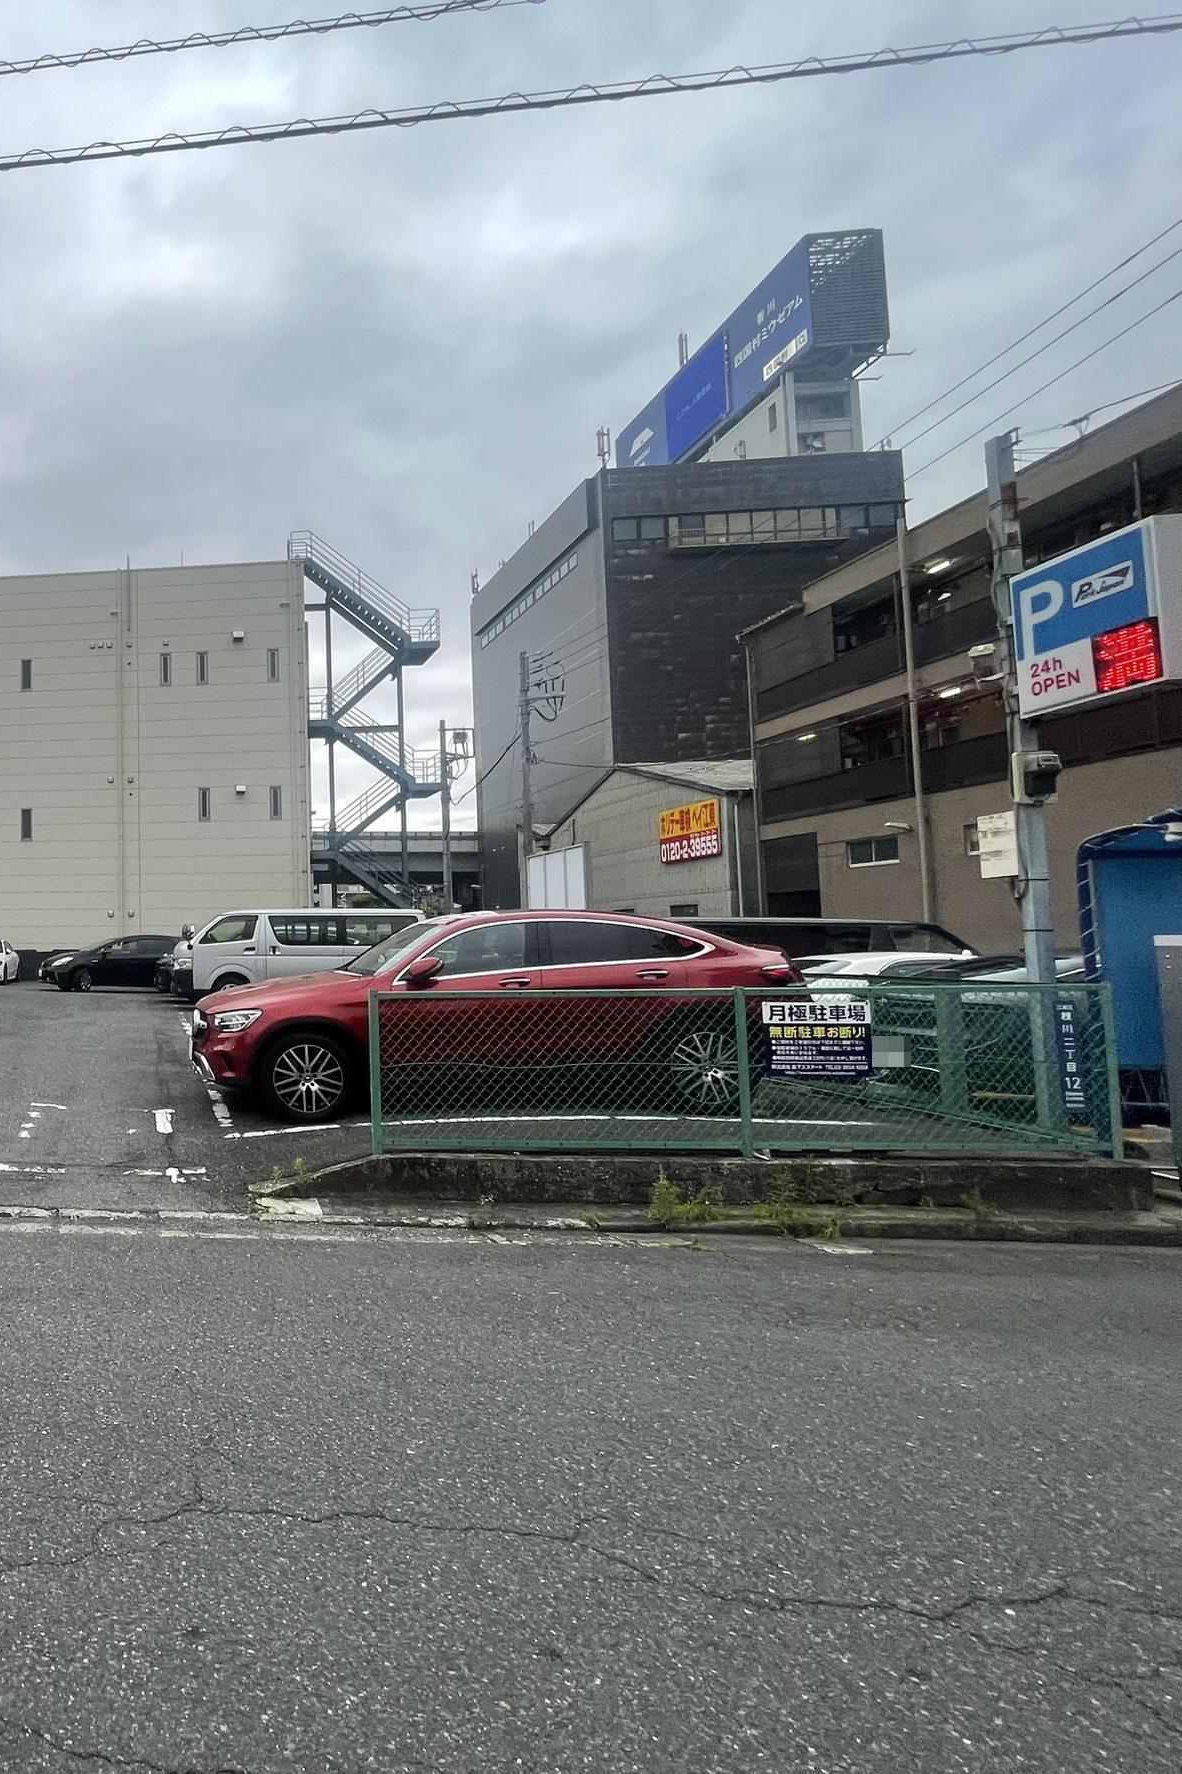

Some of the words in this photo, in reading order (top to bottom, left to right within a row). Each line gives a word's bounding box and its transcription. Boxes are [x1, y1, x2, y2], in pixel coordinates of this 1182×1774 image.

[1020, 580, 1064, 660] P
[1030, 657, 1062, 679] 24h
[1031, 669, 1081, 697] OPEN
[661, 833, 719, 862] 0120-2-39555
[769, 1004, 866, 1022] 月極駐車場
[769, 1026, 866, 1039] 無断駐車お断り!
[1065, 1076, 1081, 1090] 12
